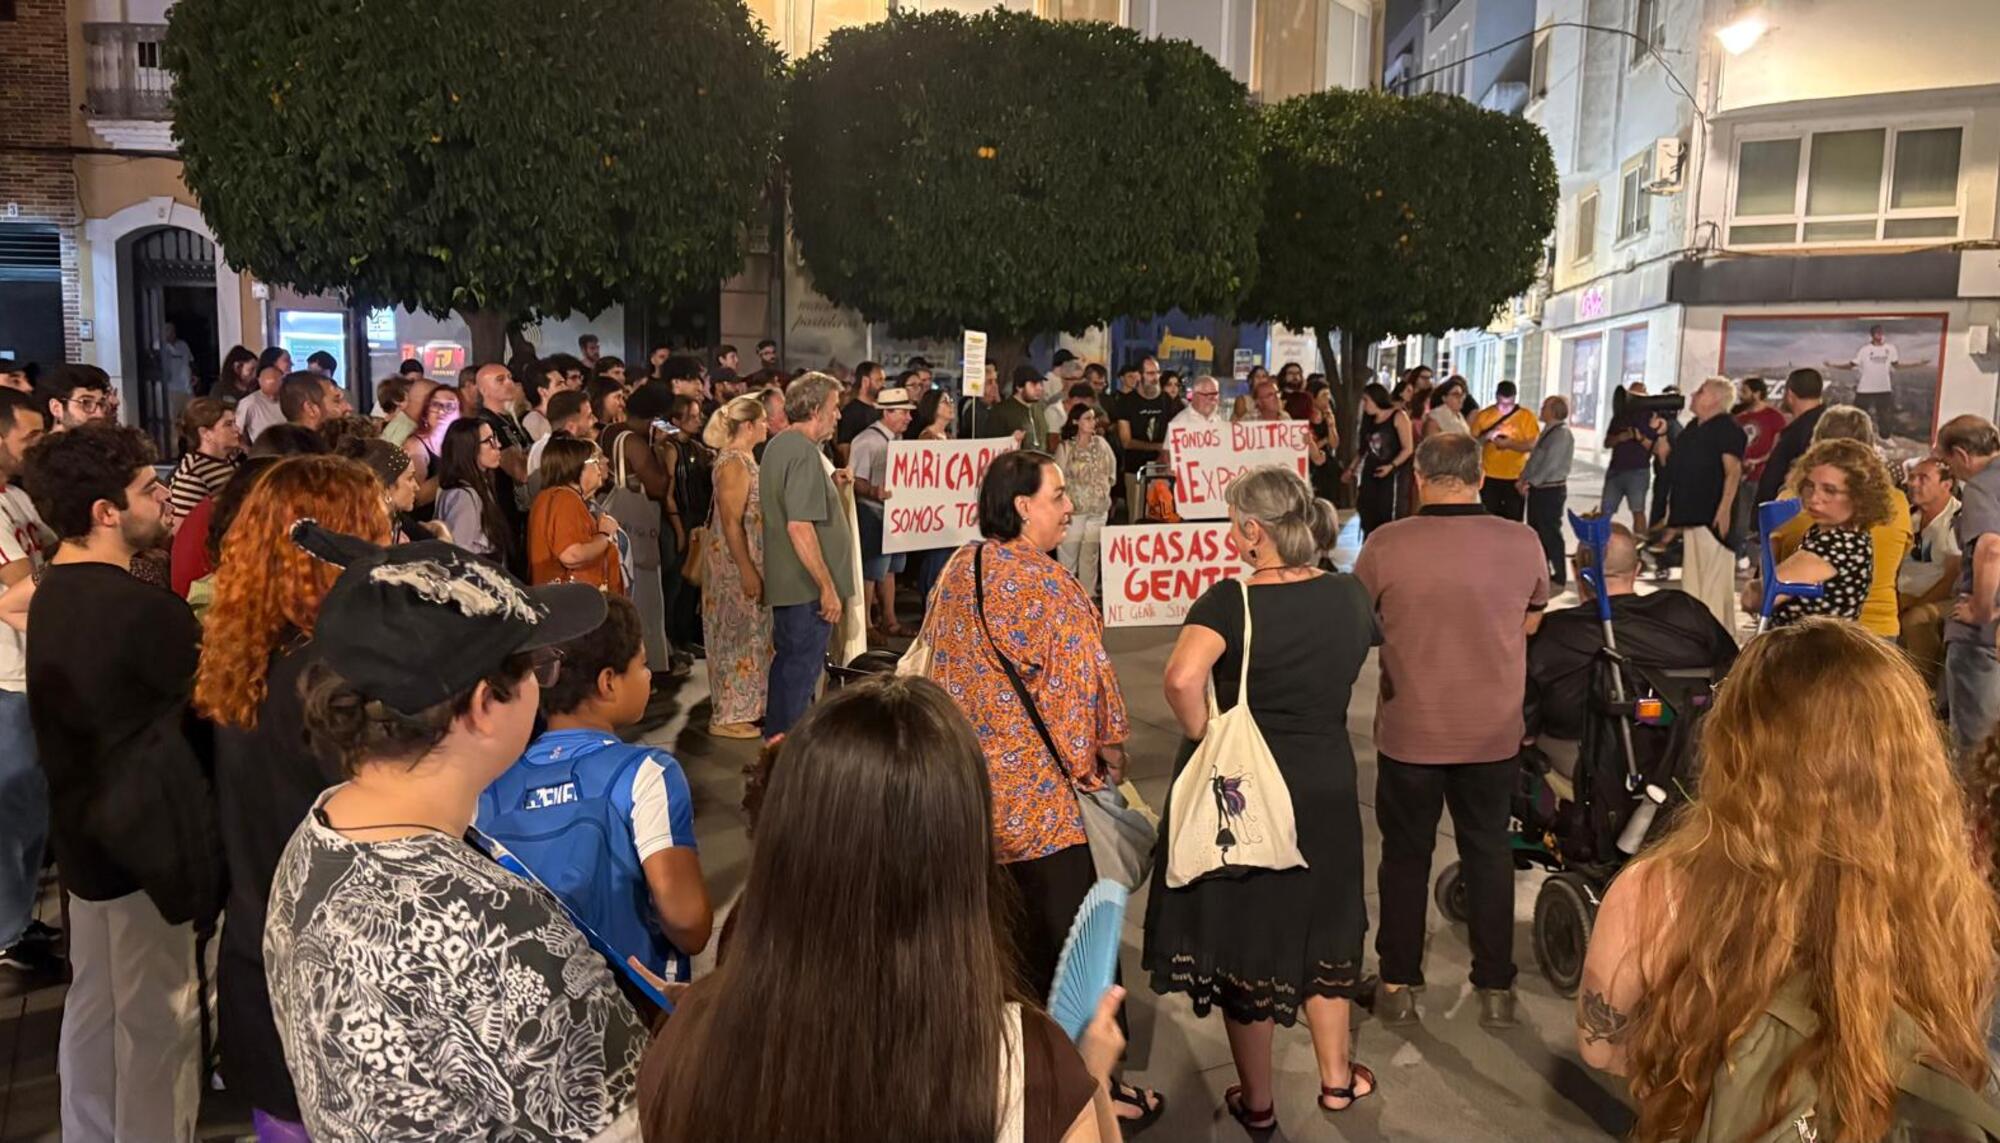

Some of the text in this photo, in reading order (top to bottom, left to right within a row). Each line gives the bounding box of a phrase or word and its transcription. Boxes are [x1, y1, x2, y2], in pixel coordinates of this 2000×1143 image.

[1171, 421, 1310, 454] FONDOS BUITRES
[891, 504, 945, 533] SOMOS
